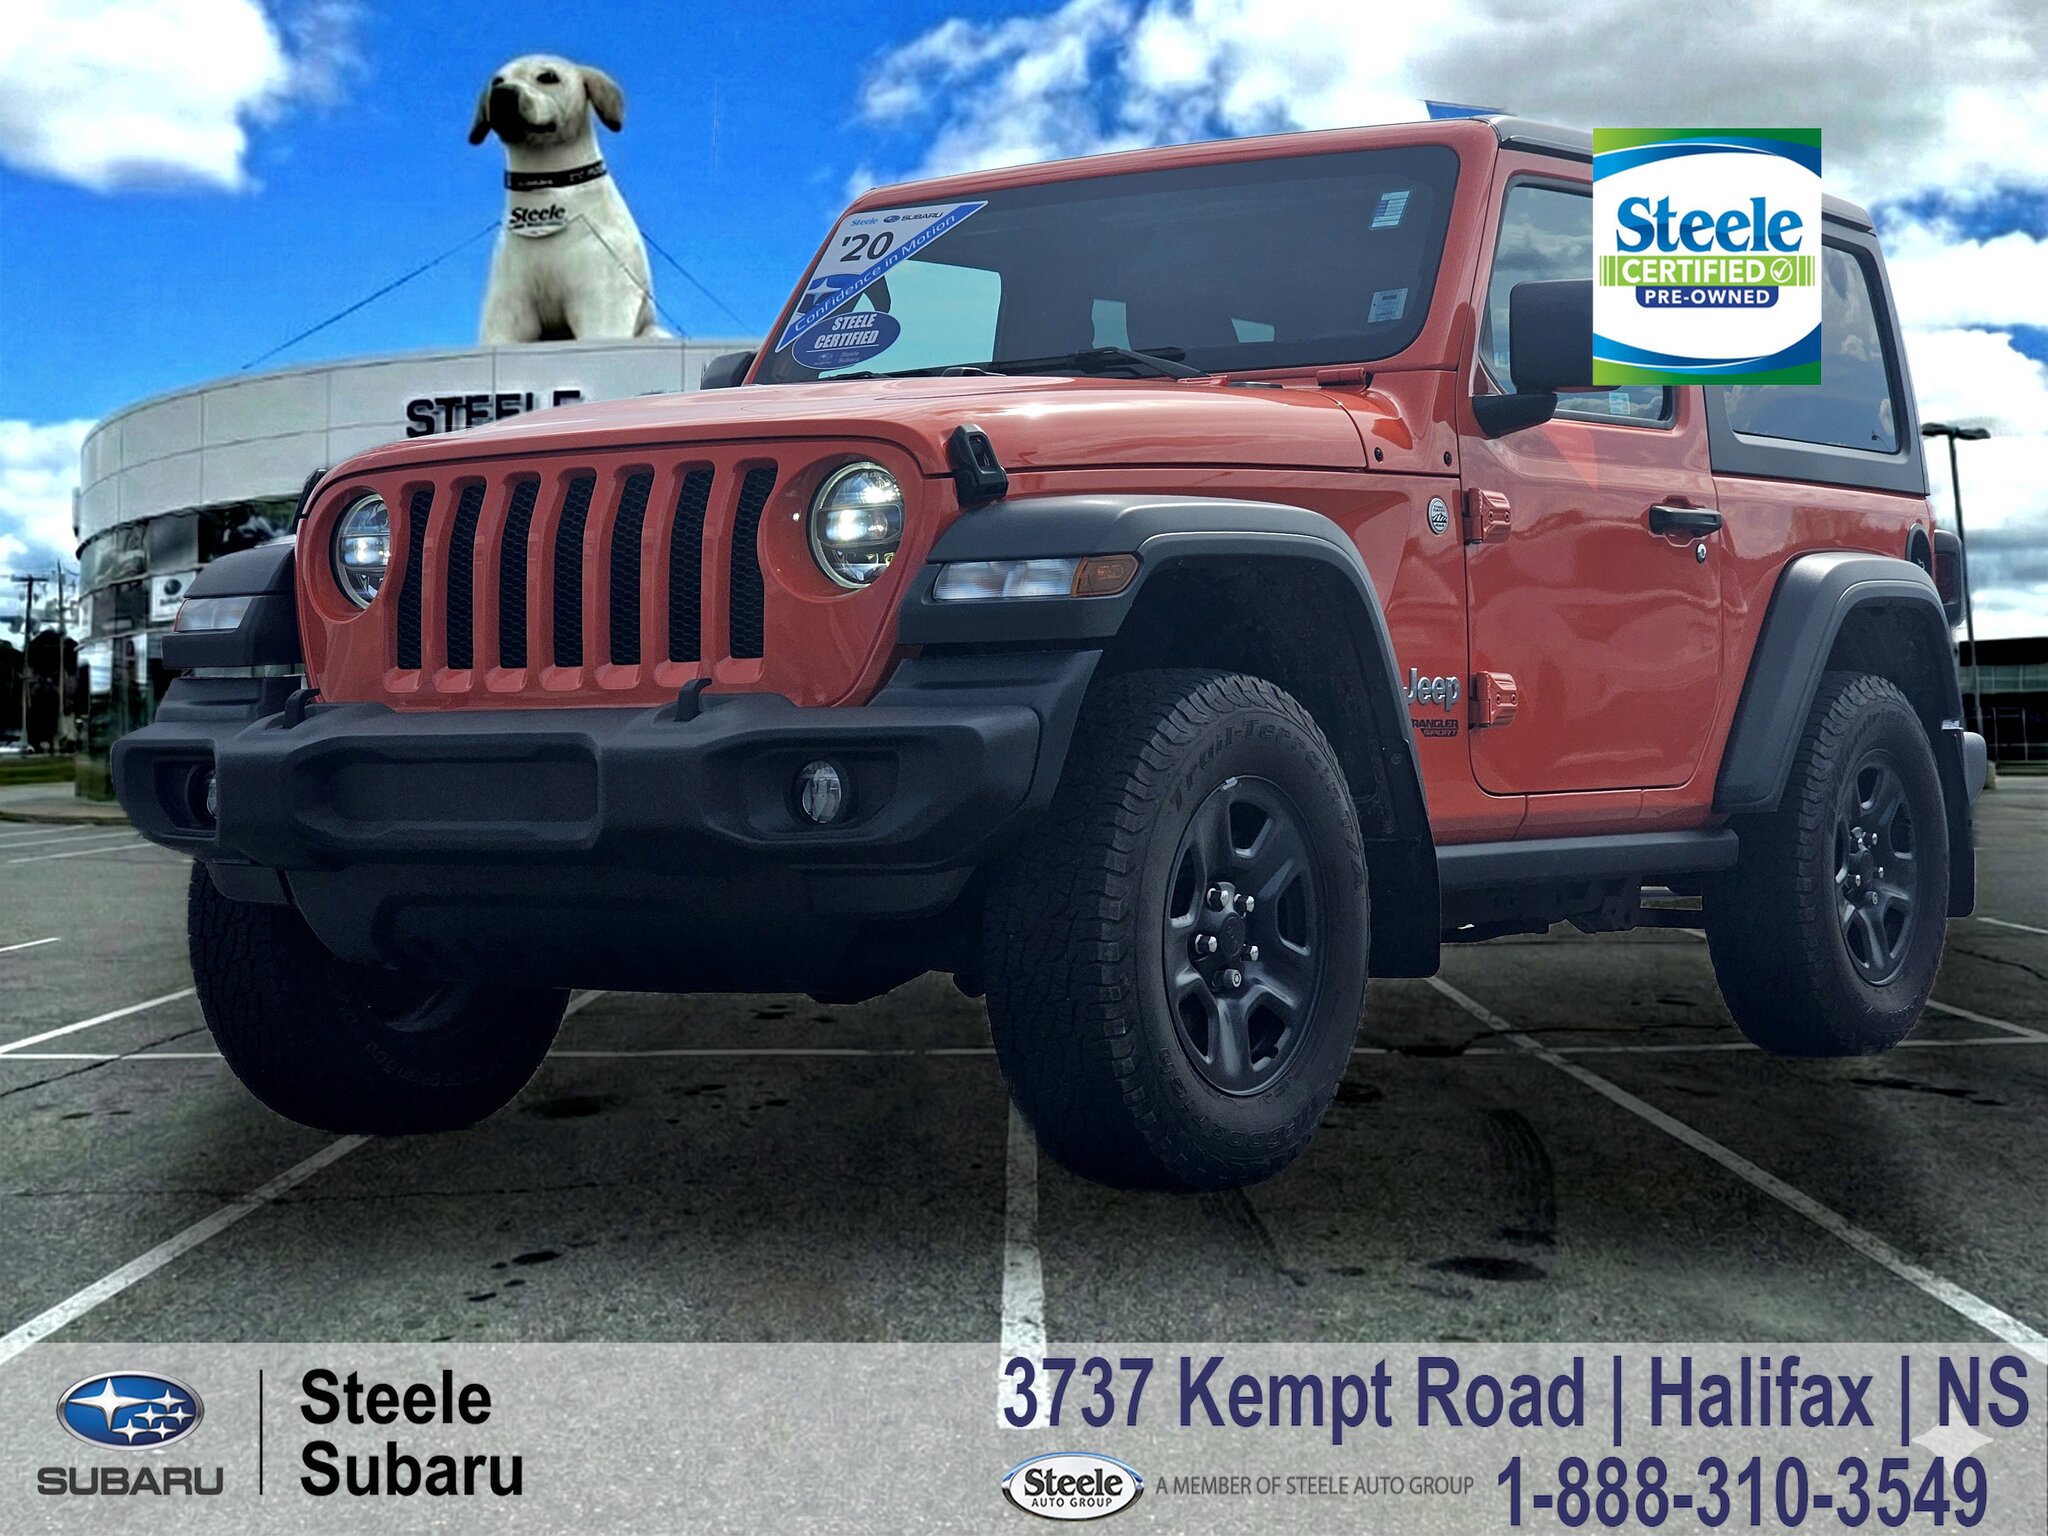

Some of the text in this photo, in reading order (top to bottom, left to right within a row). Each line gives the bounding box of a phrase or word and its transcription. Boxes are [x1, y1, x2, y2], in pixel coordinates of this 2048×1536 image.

[850, 212, 943, 226] Steele SUBARU
[840, 231, 894, 262] '20
[795, 215, 955, 331] Confidence in Motion
[832, 314, 877, 331] STEELE
[814, 330, 879, 349] CERTIFIED
[1404, 667, 1460, 711] Jeep
[1411, 719, 1458, 728] RANGLER
